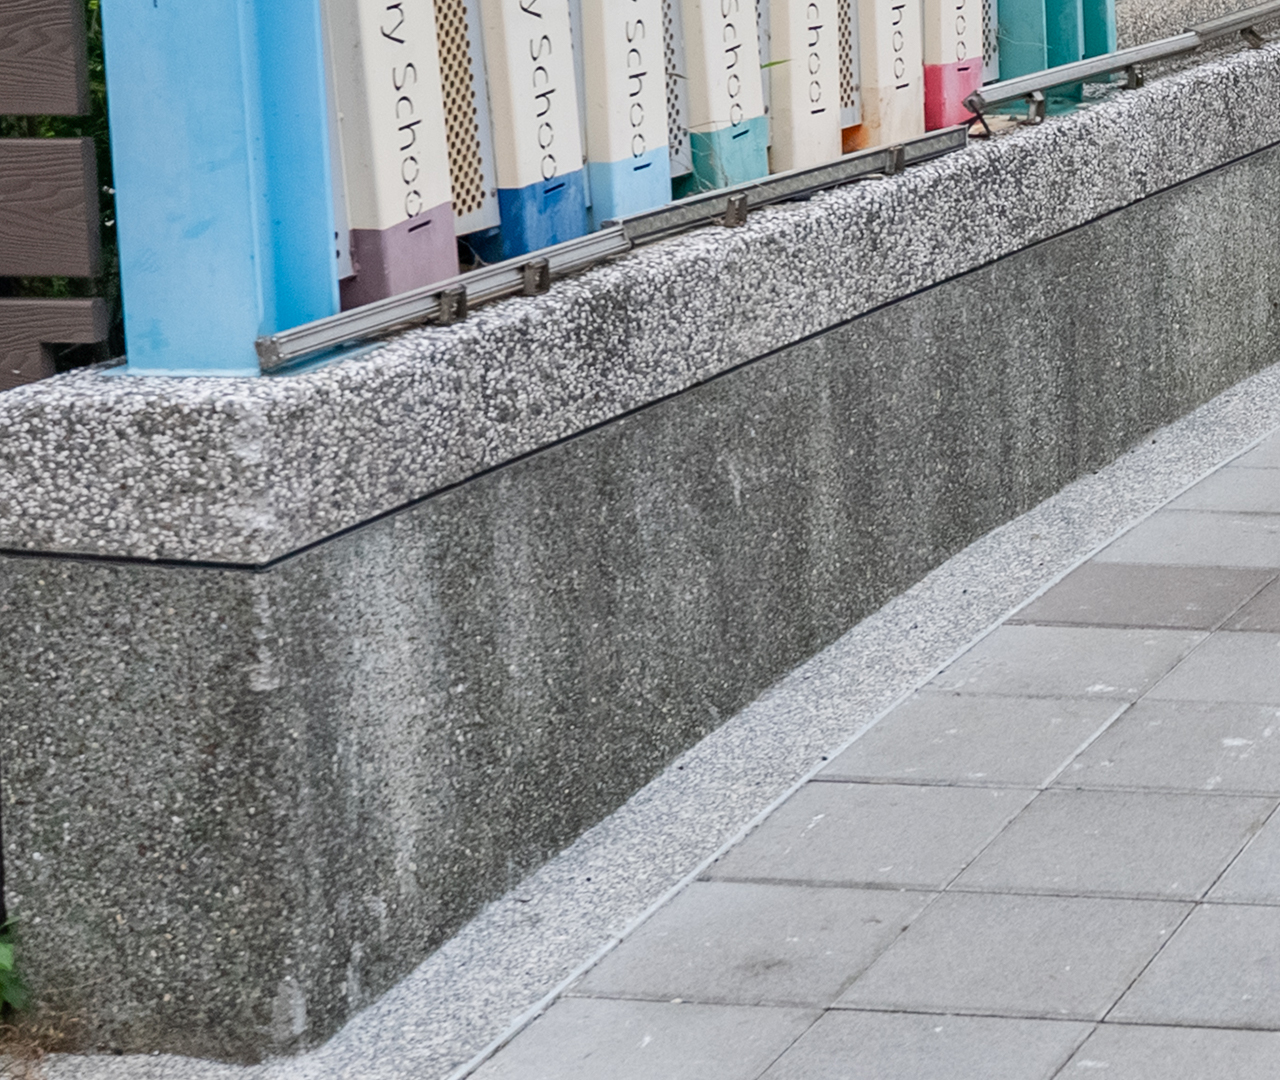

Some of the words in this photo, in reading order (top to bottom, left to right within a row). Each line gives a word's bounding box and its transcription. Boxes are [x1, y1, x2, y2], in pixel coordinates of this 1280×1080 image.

[391, 62, 431, 234] School
[530, 34, 566, 195] School
[626, 18, 652, 173] School
